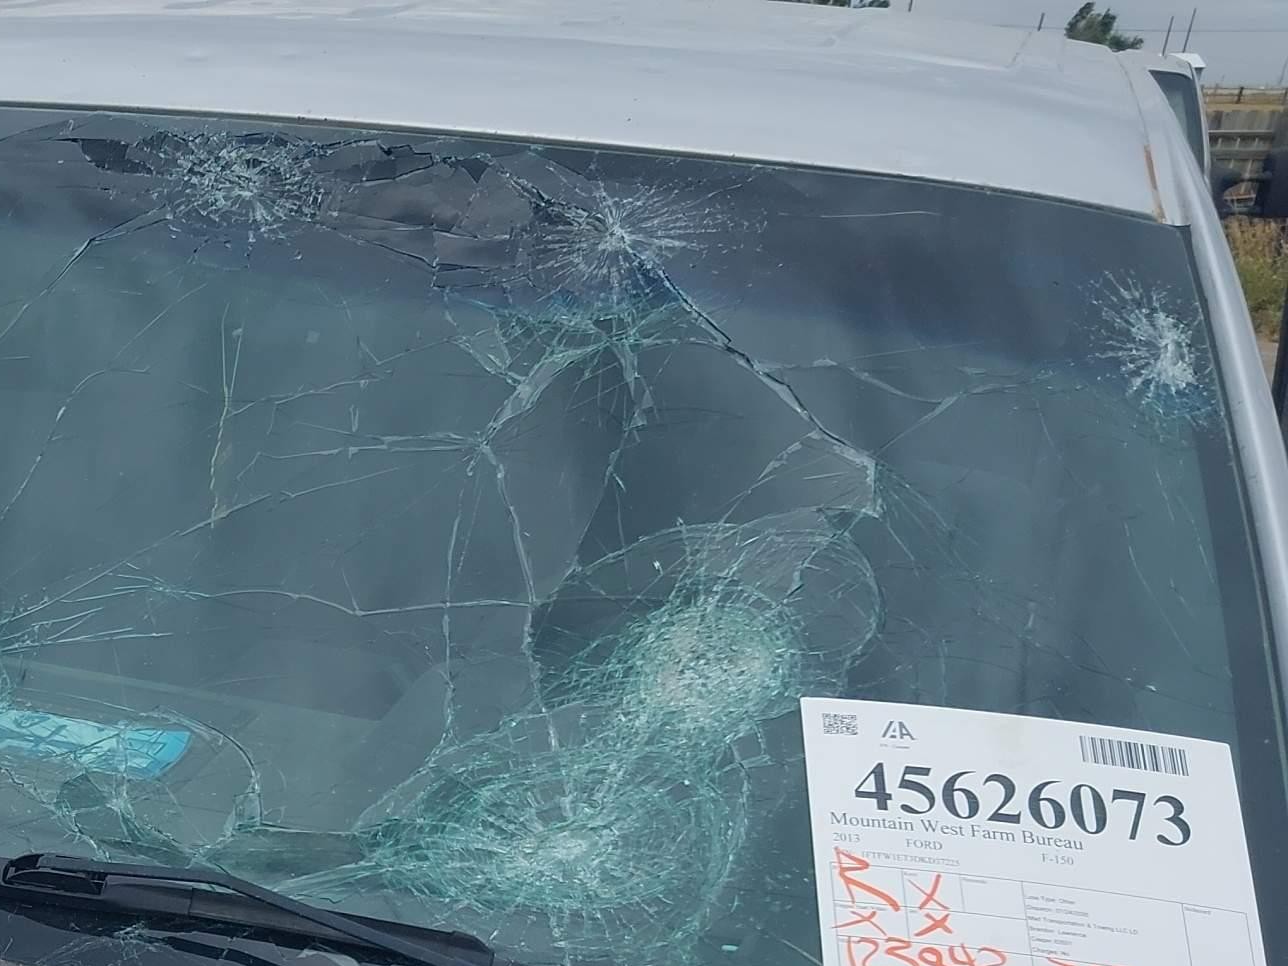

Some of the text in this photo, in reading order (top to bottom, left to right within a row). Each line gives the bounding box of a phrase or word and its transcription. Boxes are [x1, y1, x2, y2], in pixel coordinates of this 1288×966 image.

[854, 761, 1192, 847] 45626073
[830, 811, 1084, 851] Mountain West Farm Bureau
[832, 832, 1075, 867] 2013 FORD F-150
[833, 845, 901, 912] R
